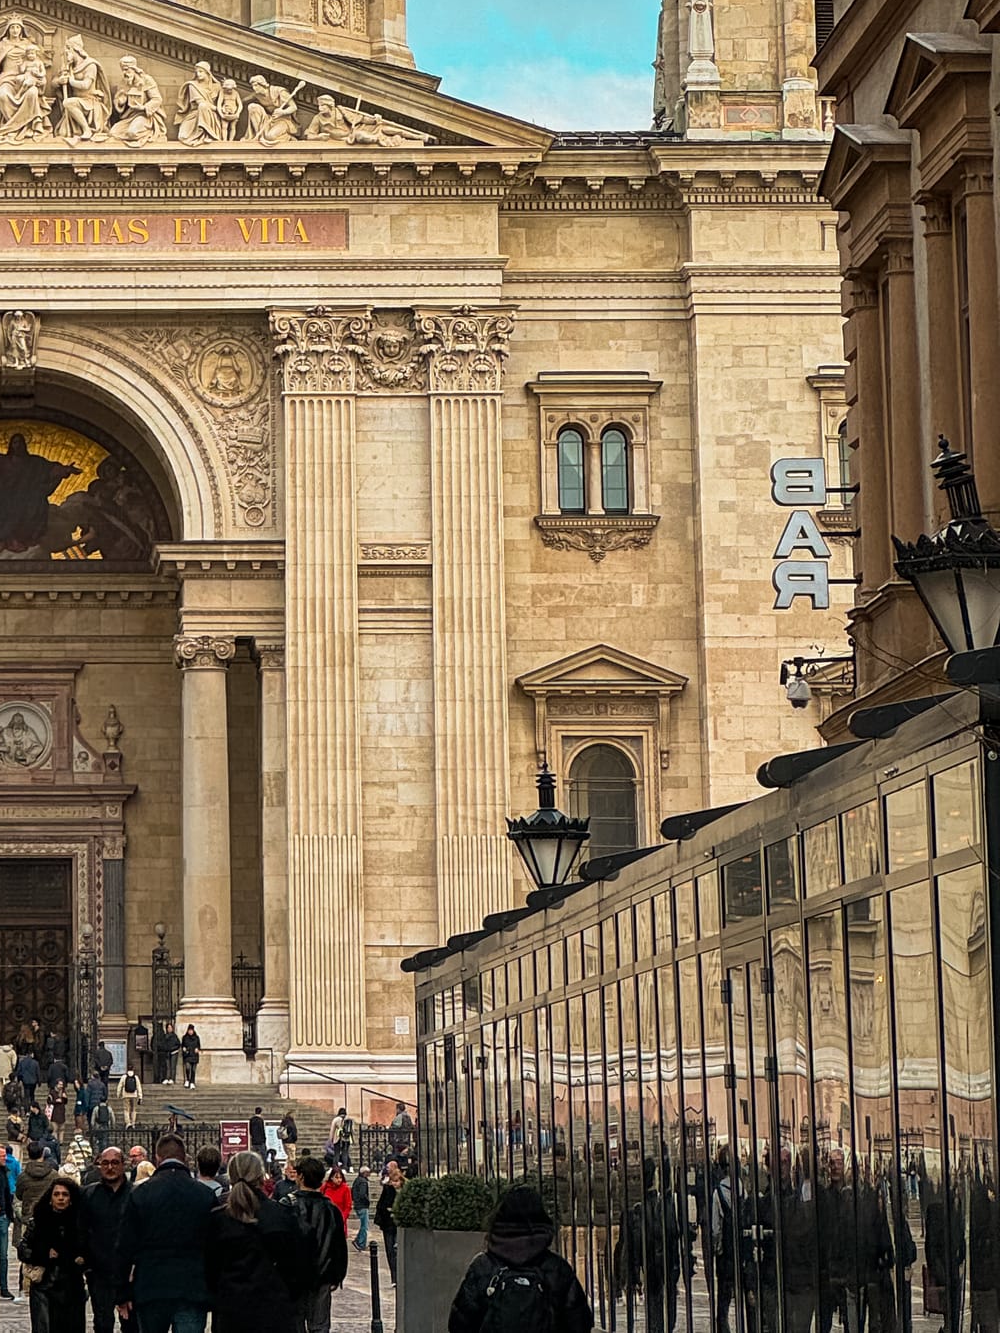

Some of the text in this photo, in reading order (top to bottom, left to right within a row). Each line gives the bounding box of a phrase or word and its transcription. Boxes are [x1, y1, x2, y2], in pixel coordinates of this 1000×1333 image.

[7, 217, 151, 245] VERITAS
[172, 217, 214, 245] ET
[236, 217, 312, 245] VITA
